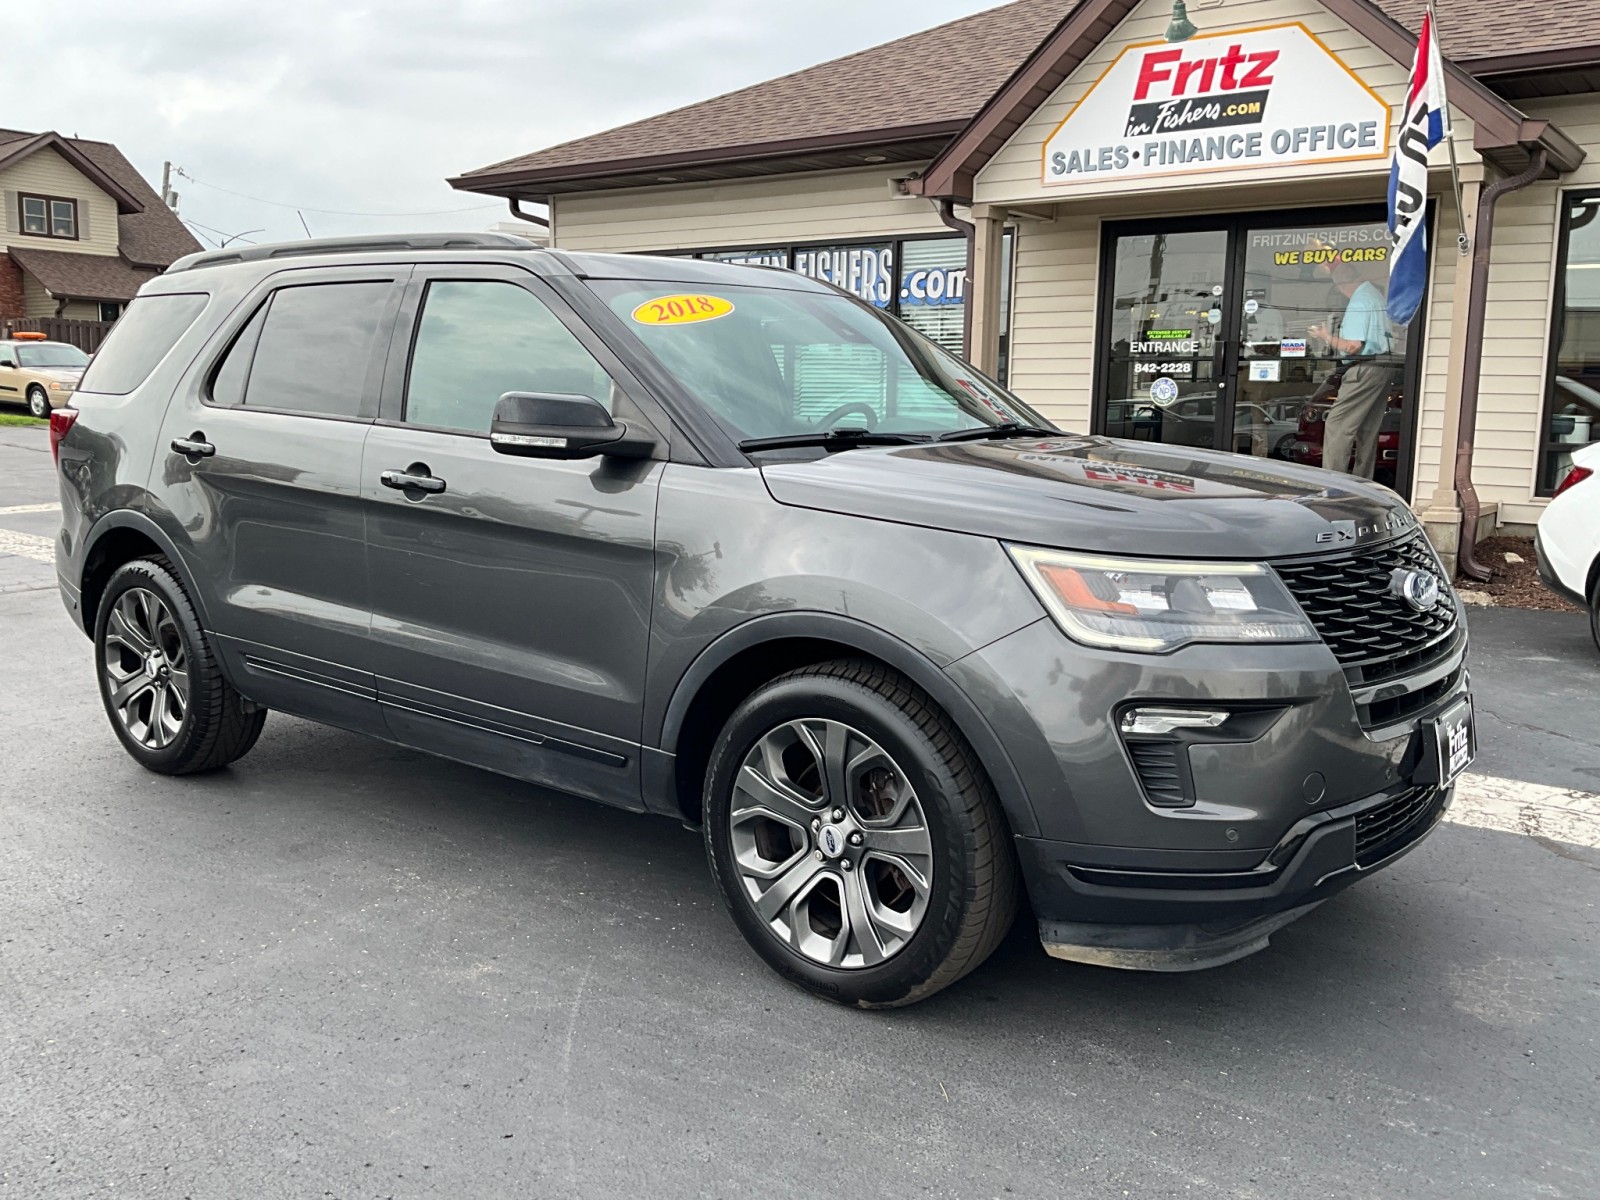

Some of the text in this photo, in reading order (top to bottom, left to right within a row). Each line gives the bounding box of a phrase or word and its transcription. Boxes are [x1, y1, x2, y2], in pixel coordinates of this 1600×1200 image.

[1133, 44, 1280, 101] Fritz
[1126, 116, 1151, 137] in
[1152, 100, 1221, 135] Fishers
[1051, 121, 1378, 175] SALES FINANCE OFFICE
[1252, 228, 1394, 247] FRITZINFISHERS.CO
[1274, 247, 1387, 265] WE BUY CARS
[650, 297, 714, 321] 2018
[1130, 341, 1199, 353] ENTRANCE
[1134, 362, 1191, 373] 842-2228
